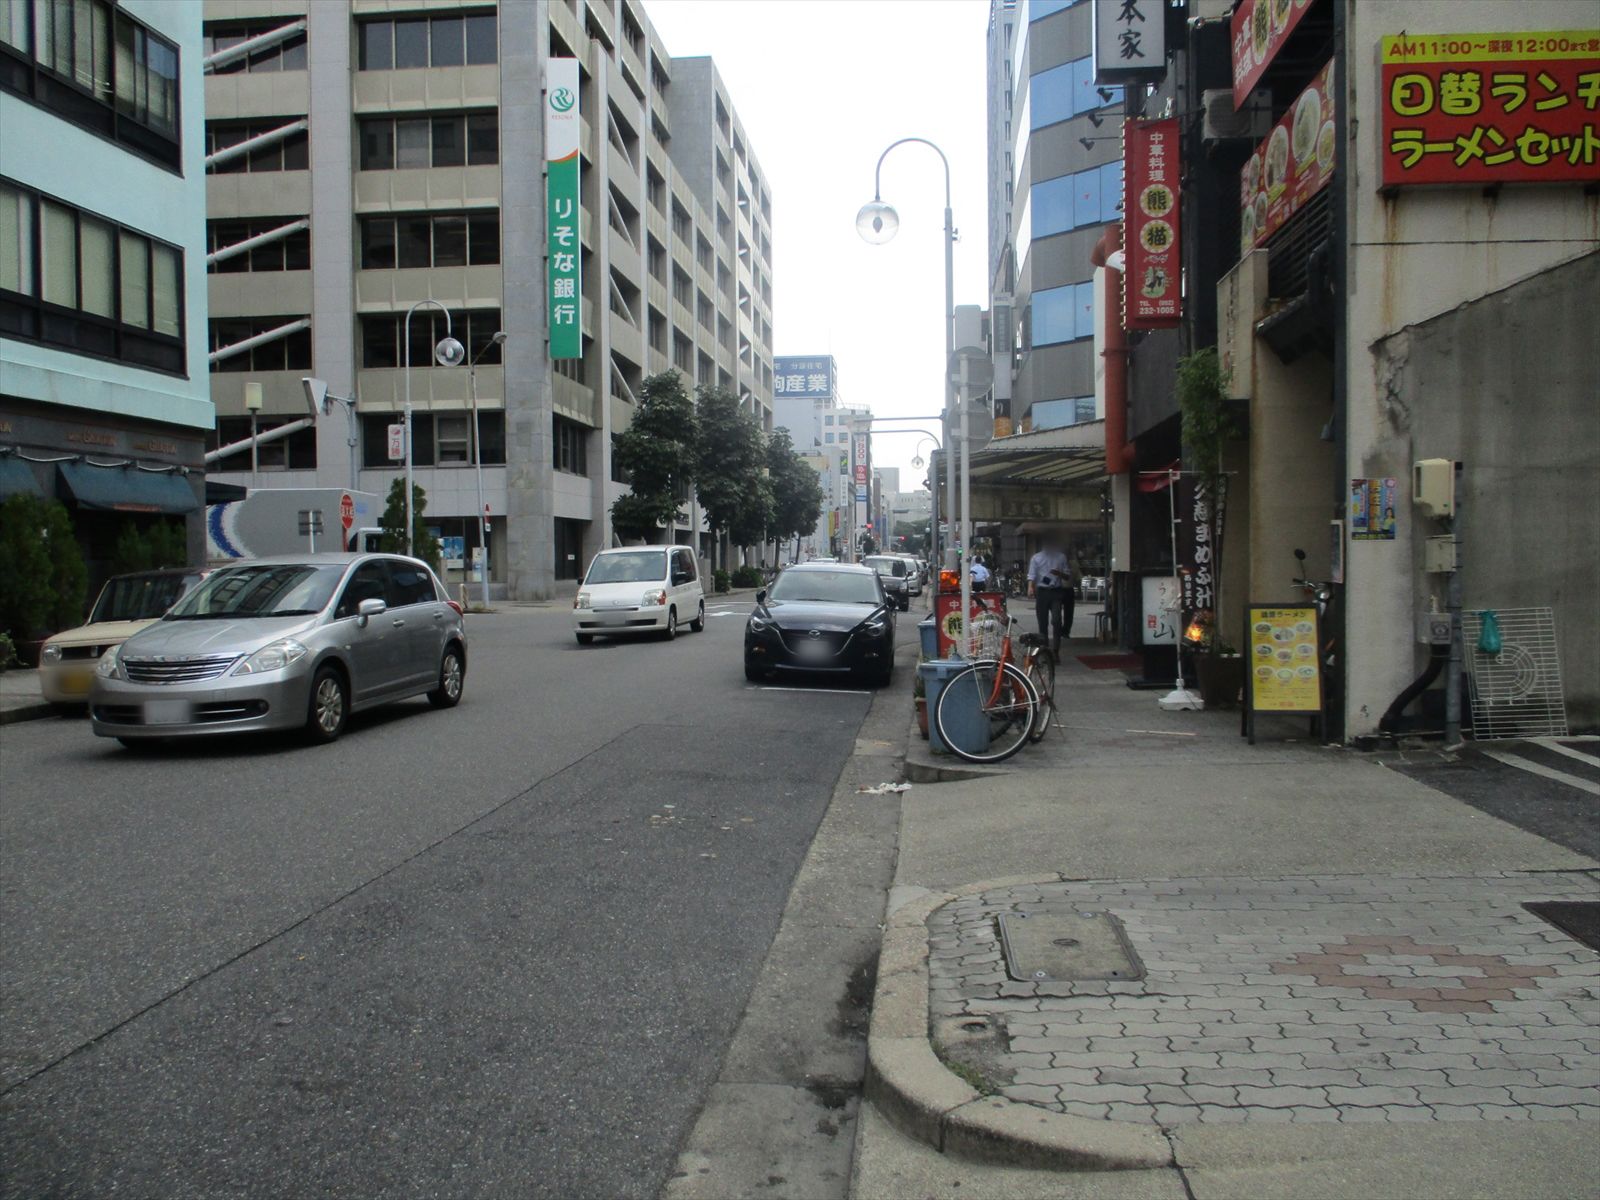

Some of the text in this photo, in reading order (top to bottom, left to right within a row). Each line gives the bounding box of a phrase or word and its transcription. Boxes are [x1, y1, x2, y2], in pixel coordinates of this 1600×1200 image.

[1148, 131, 1165, 181] 中華料理
[553, 198, 575, 325] りそな銀行
